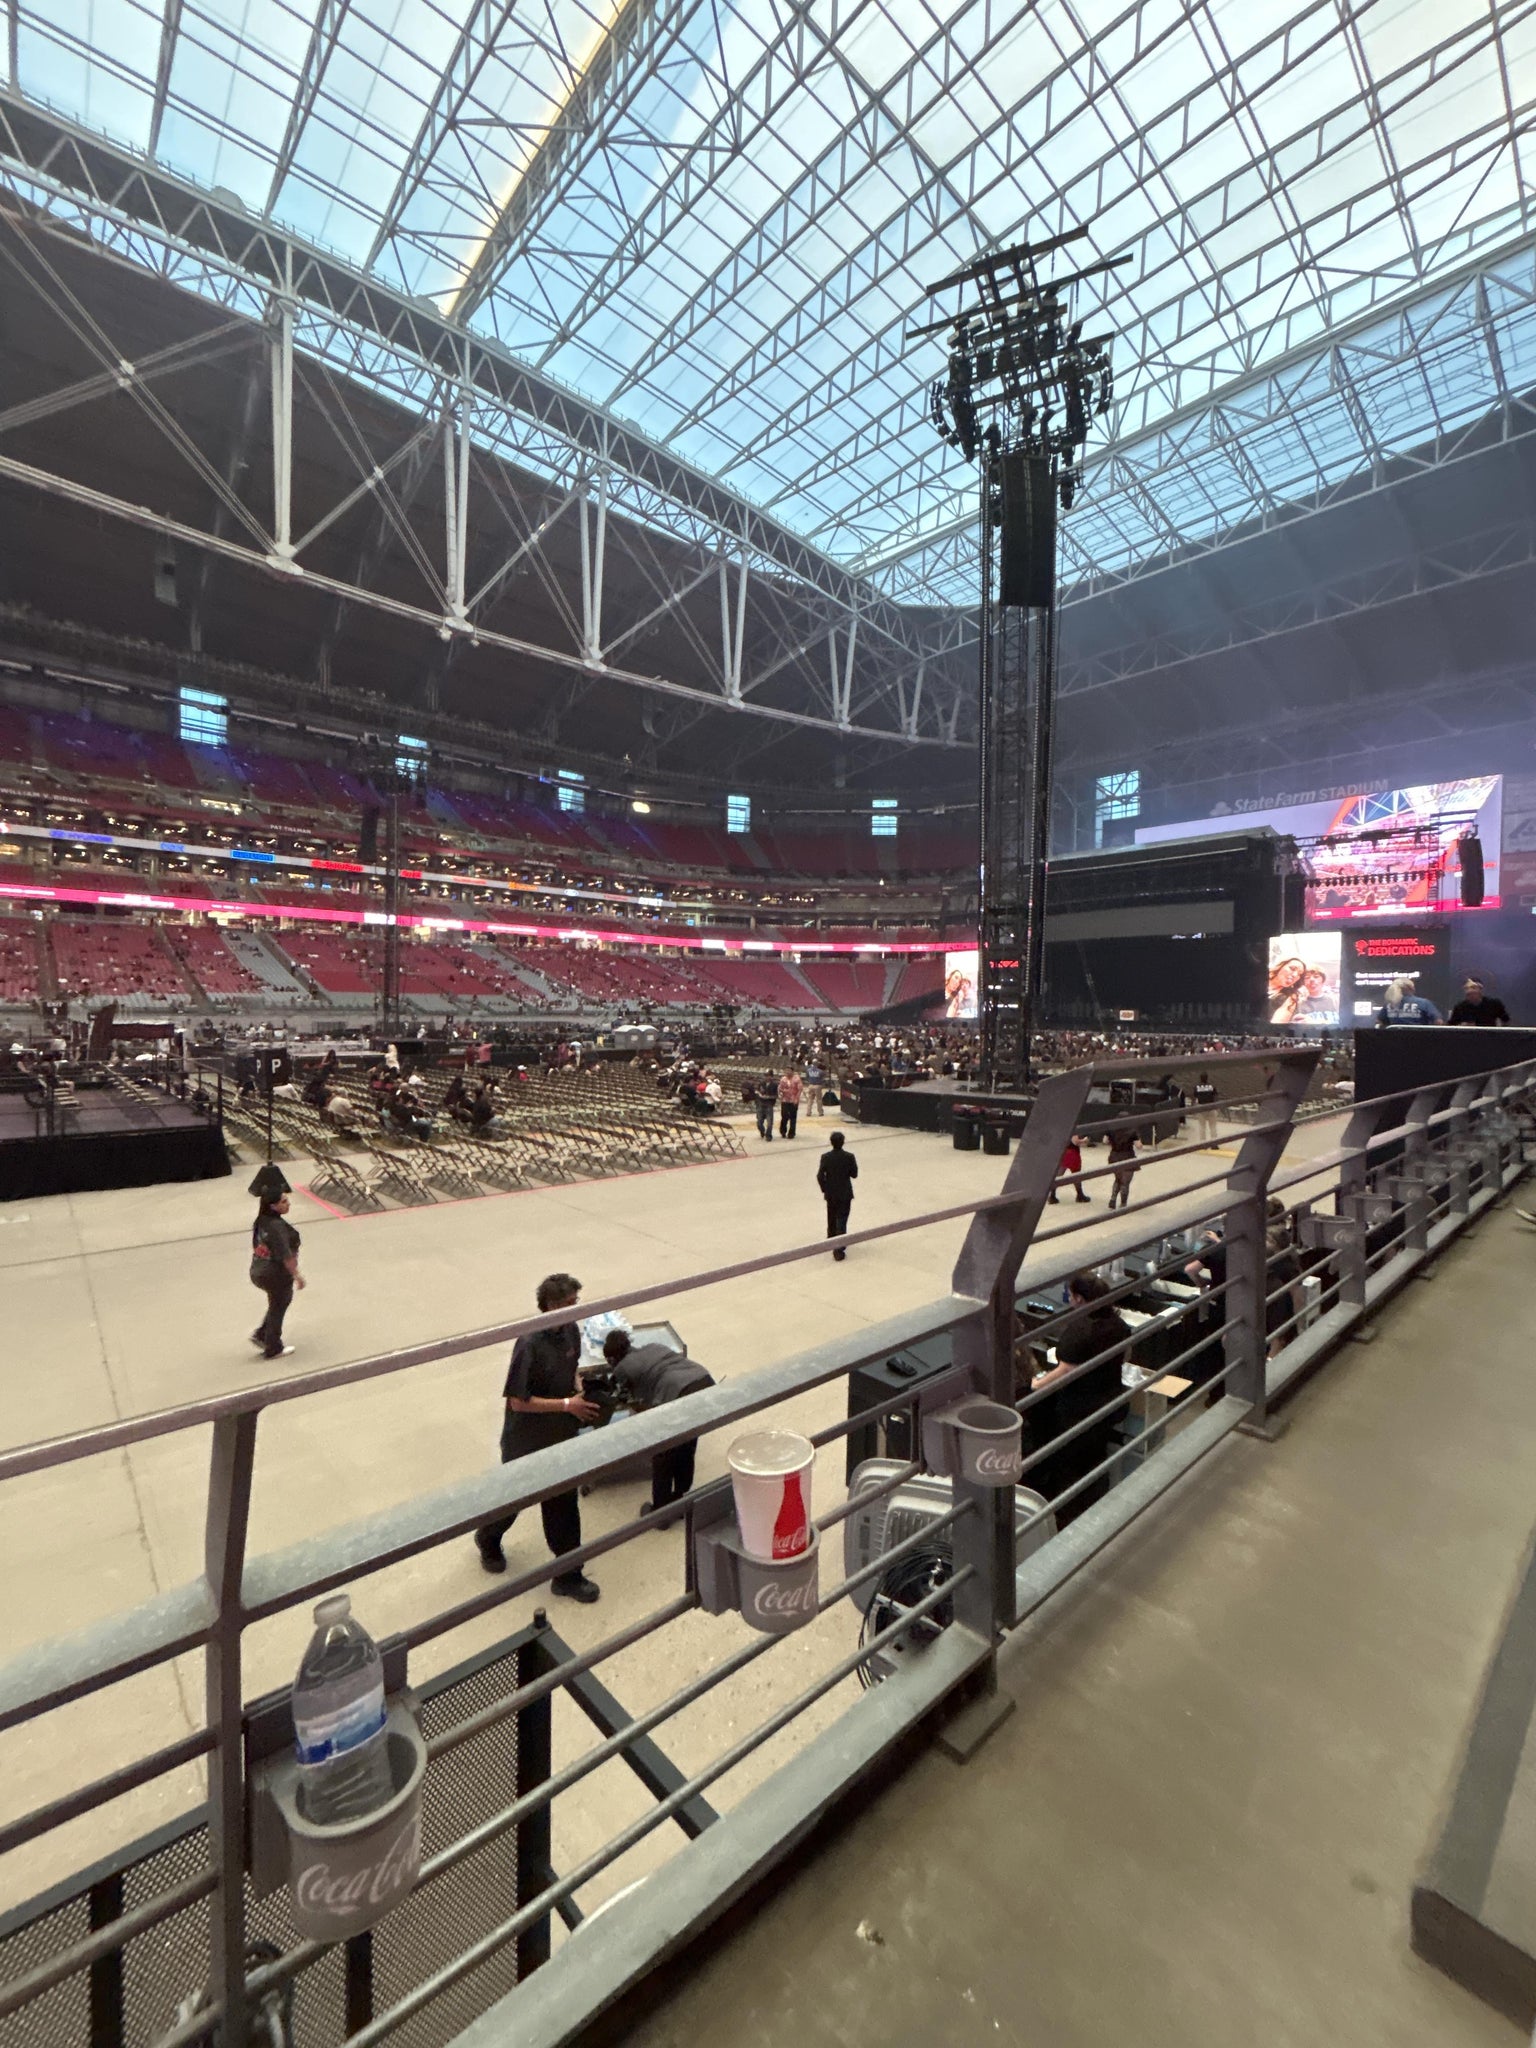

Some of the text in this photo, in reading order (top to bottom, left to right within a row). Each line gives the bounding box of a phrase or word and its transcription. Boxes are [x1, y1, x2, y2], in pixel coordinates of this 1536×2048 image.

[1319, 779, 1389, 801] STADIUM
[1368, 945, 1435, 956] DEDICATIONS
[272, 1059, 281, 1073] P
